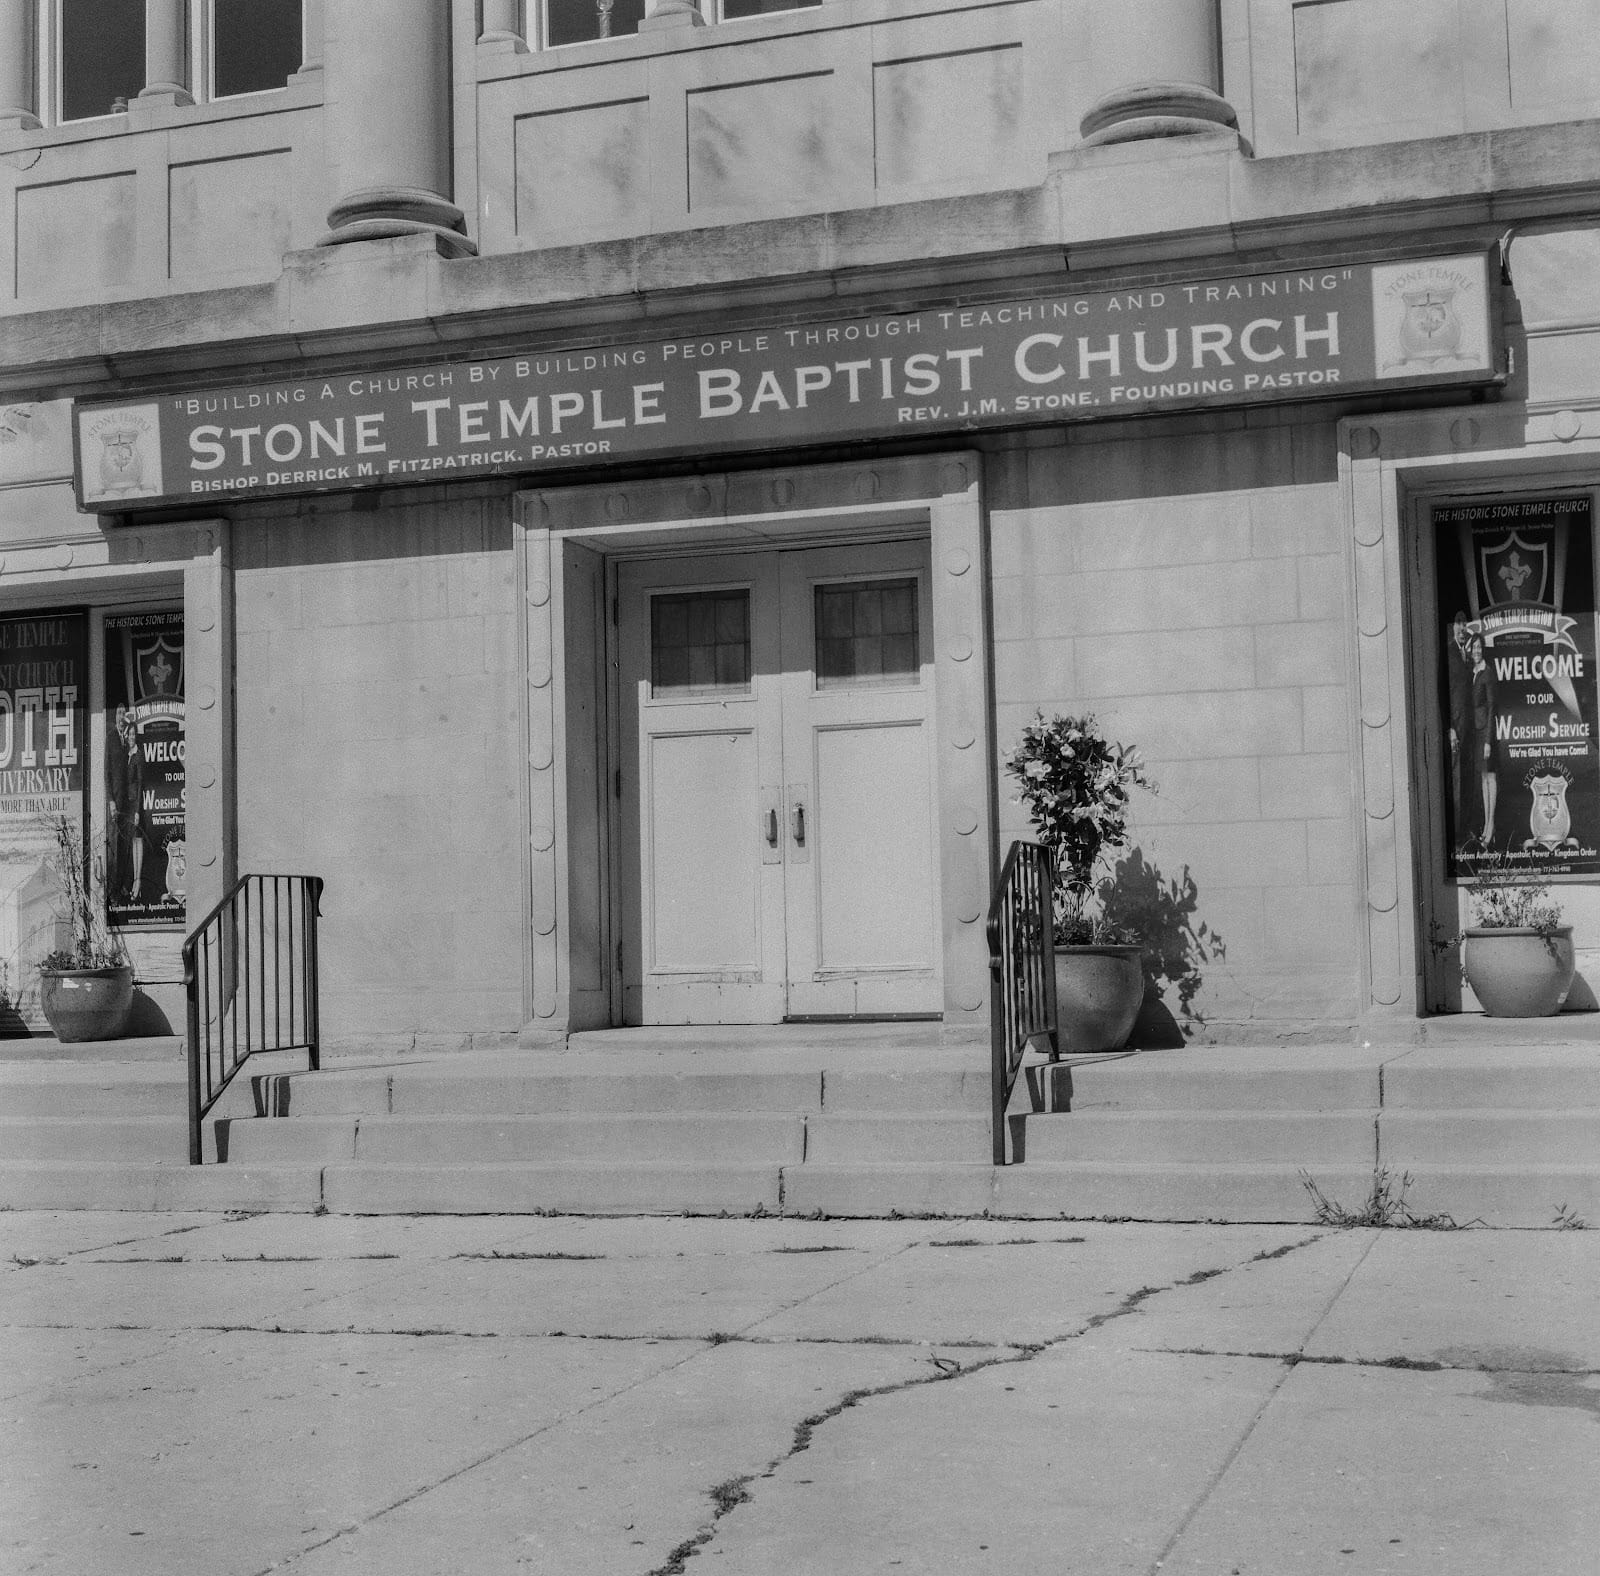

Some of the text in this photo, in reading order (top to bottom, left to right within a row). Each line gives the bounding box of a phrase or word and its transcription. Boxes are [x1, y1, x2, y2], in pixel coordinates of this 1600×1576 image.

[320, 383, 335, 400] A
[348, 371, 454, 396] CHURCH
[469, 364, 500, 384] BY
[516, 350, 647, 378] BUILDING
[663, 335, 770, 361] PEOPLE
[785, 318, 922, 347] THROUGH
[938, 300, 1090, 330] TEACHING
[1107, 291, 1166, 312] AND
[188, 311, 1341, 471] STONE TEMPLE BAPTIST CHURCH
[898, 405, 950, 423] REV.
[957, 396, 1006, 418] J.M.
[1110, 376, 1235, 402] FOUNDING
[1244, 368, 1342, 390] PASTOR
[190, 475, 260, 494] BISHOP
[266, 465, 351, 487] DERRICK
[357, 461, 381, 477] M.
[531, 439, 612, 461] PASTOR
[1434, 499, 1590, 522] THE HISTORIC STONE TEMPLE CHURCH
[105, 613, 185, 629] THE HISTORIC STONE TEMPL
[15, 619, 69, 649] TEMPLE
[17, 659, 74, 688] CHURCH
[1494, 653, 1584, 682] WELCOME
[1526, 693, 1554, 705] TO OUR
[1495, 712, 1590, 740] WORSHIP SERVICE
[143, 740, 185, 763] WELCO
[1509, 748, 1528, 758] We're
[1528, 747, 1541, 757] Glad
[1542, 747, 1554, 757] You
[1554, 745, 1569, 756] have
[165, 772, 185, 782] TO OUR
[1523, 758, 1575, 790] STONE TEMPLE
[1, 799, 23, 814] MORE
[25, 798, 48, 813] THAN
[142, 789, 179, 811] WORSHIP
[1555, 847, 1579, 859] Kingdom
[1580, 847, 1597, 857] Order
